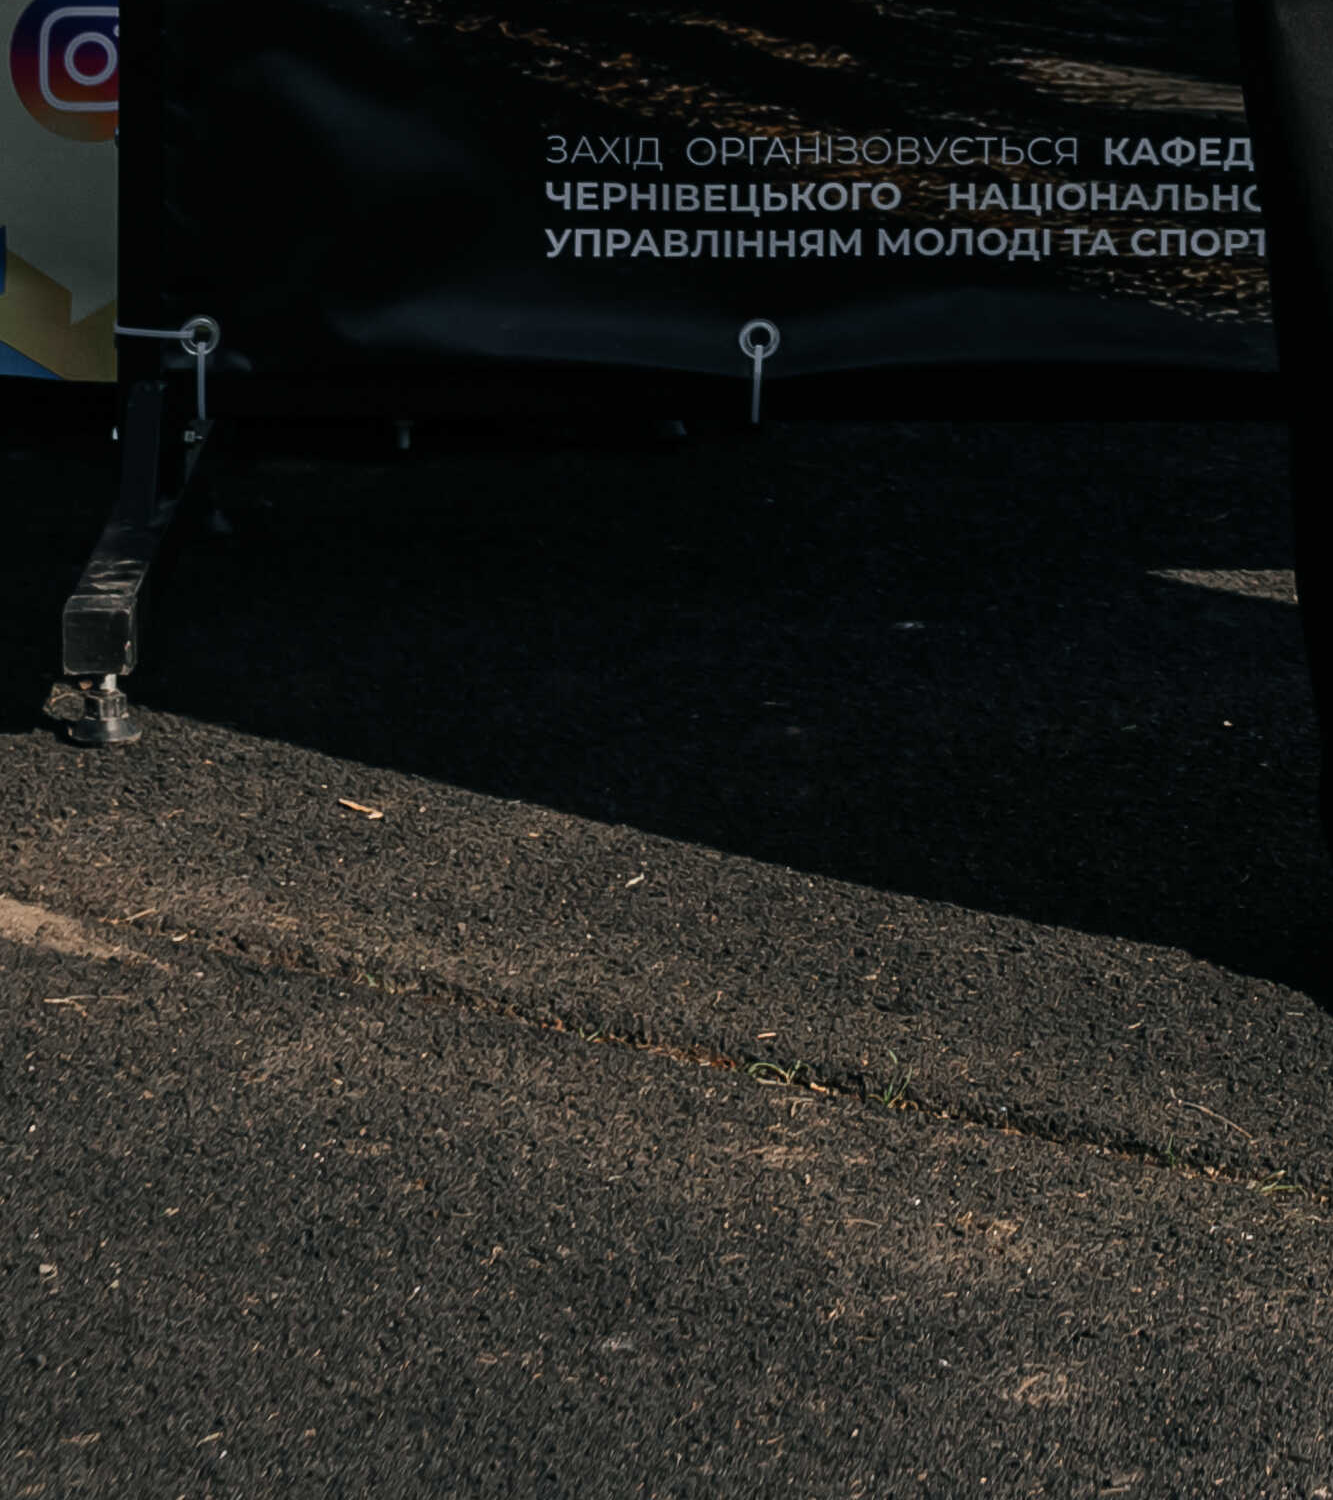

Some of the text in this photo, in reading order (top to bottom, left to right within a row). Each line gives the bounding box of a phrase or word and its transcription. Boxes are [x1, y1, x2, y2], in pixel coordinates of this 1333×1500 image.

[545, 135, 664, 171] ЗАХІД
[686, 135, 1078, 166] ОРГАНІЗОВУЄТЬСЯ
[1104, 136, 1254, 171] КАФЕД
[545, 181, 902, 218] ЧЕРНІВЕЦЬКОГО
[544, 228, 862, 258] УПРАВЛІННЯМ
[877, 227, 1051, 262] МОЛОДІ
[1063, 228, 1119, 257] ТА
